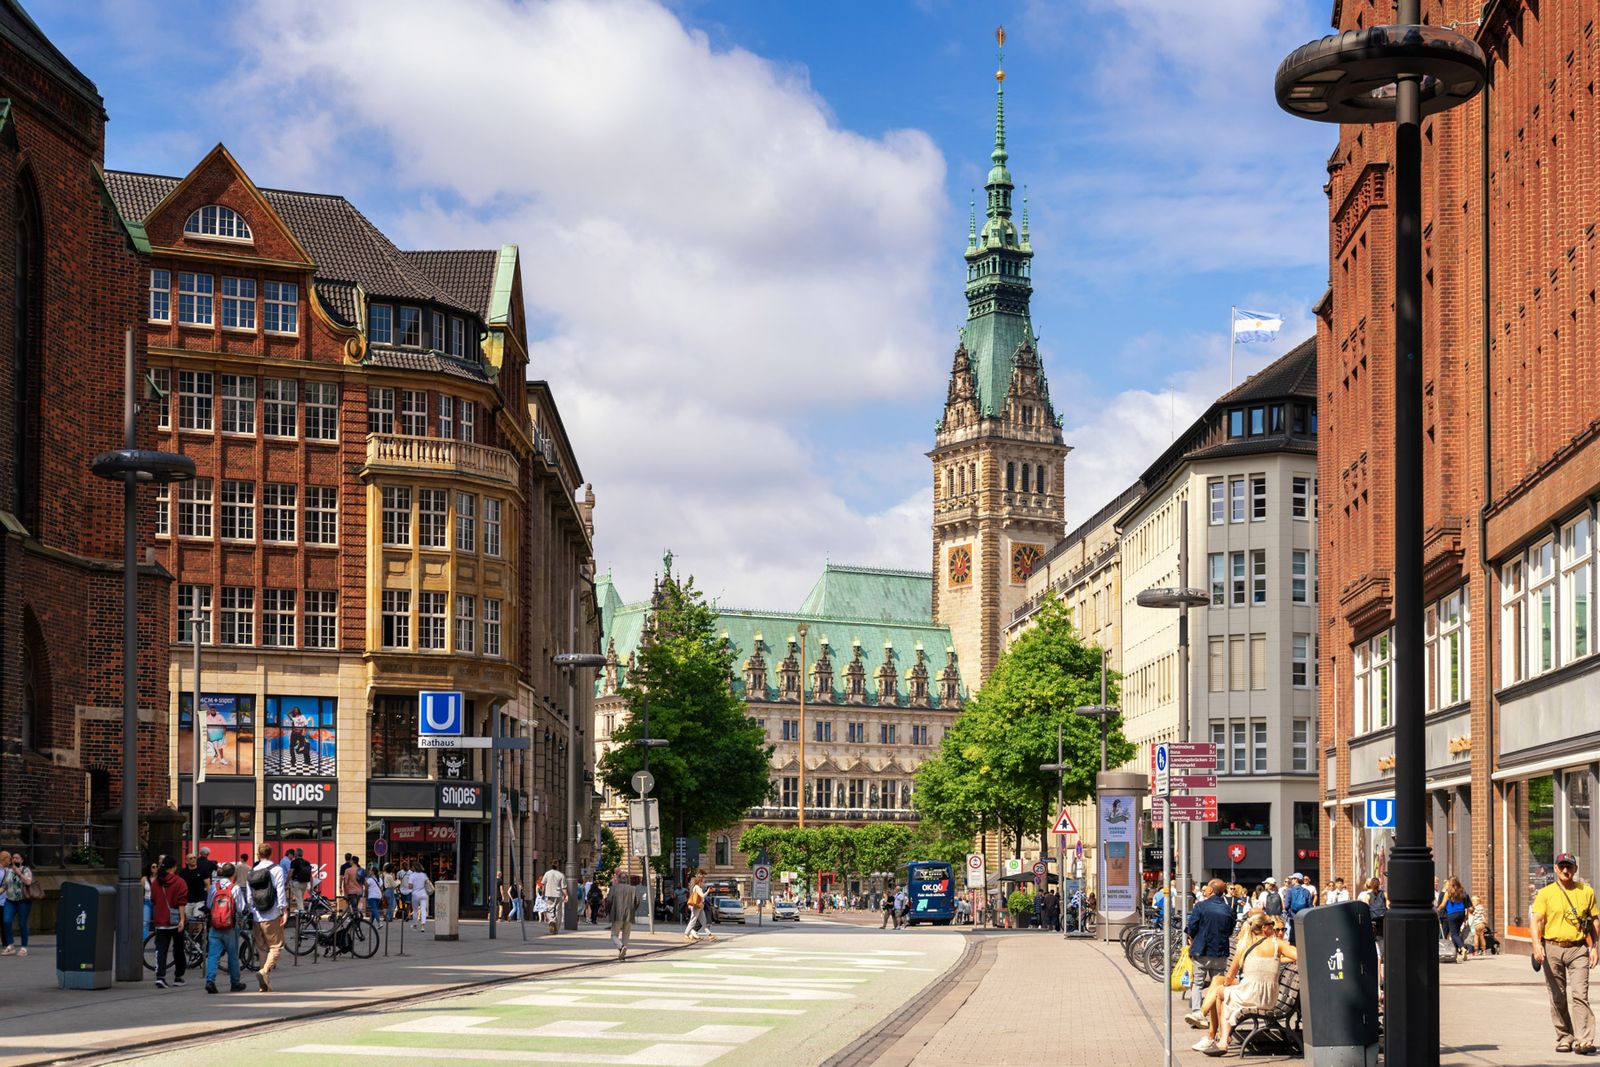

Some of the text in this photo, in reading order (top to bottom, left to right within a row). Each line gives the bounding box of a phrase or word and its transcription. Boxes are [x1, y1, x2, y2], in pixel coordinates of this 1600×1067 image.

[426, 695, 455, 731] U
[421, 738, 455, 747] Rathaus
[273, 783, 324, 805] snipes
[442, 786, 476, 807] snipes
[1370, 800, 1393, 826] U
